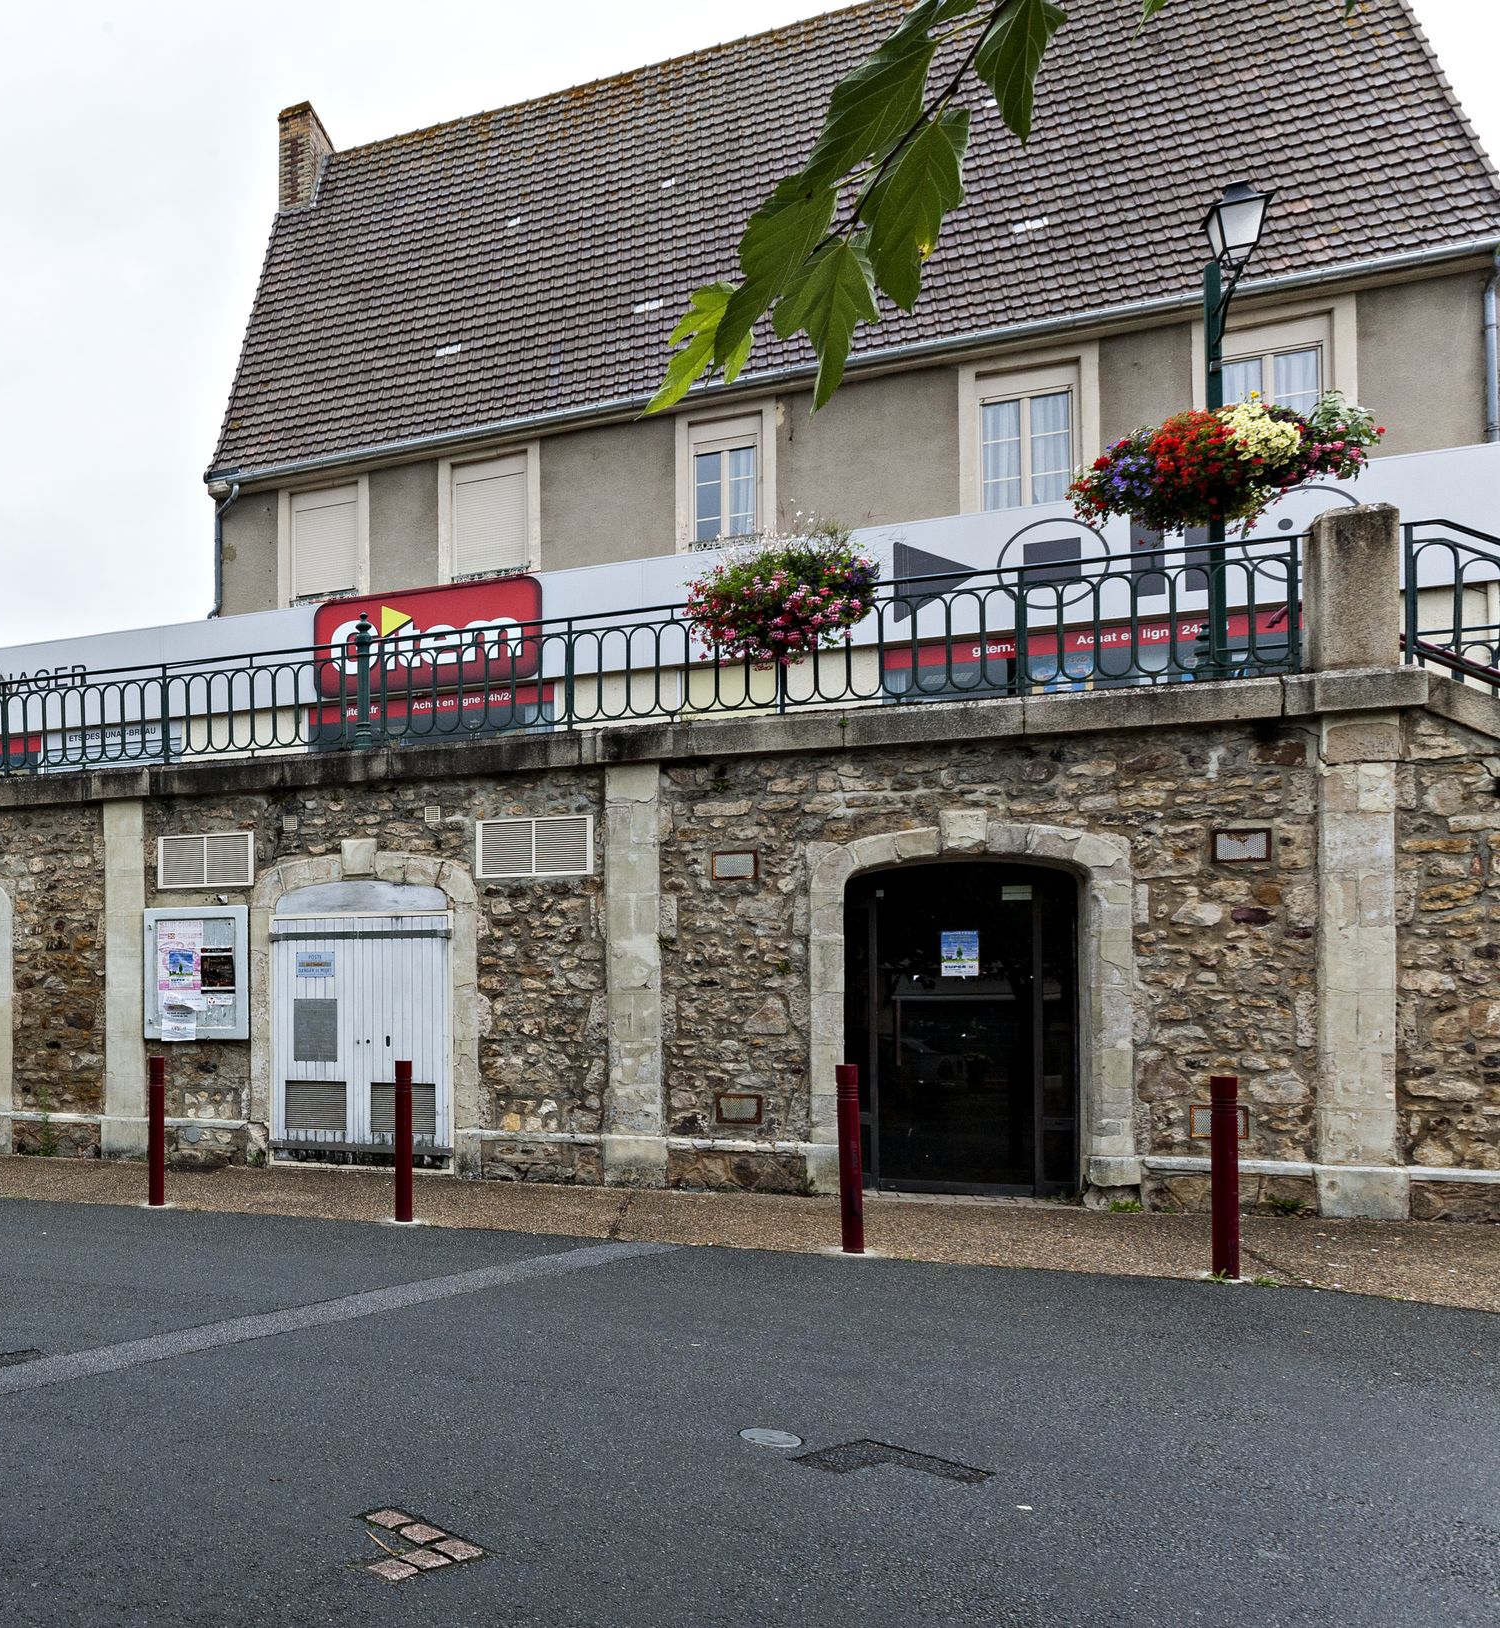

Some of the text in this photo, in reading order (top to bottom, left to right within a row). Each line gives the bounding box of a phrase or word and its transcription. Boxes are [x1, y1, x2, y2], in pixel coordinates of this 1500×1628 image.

[1142, 628, 1169, 640] lign
[331, 608, 522, 676] Gitem
[442, 699, 454, 707] en
